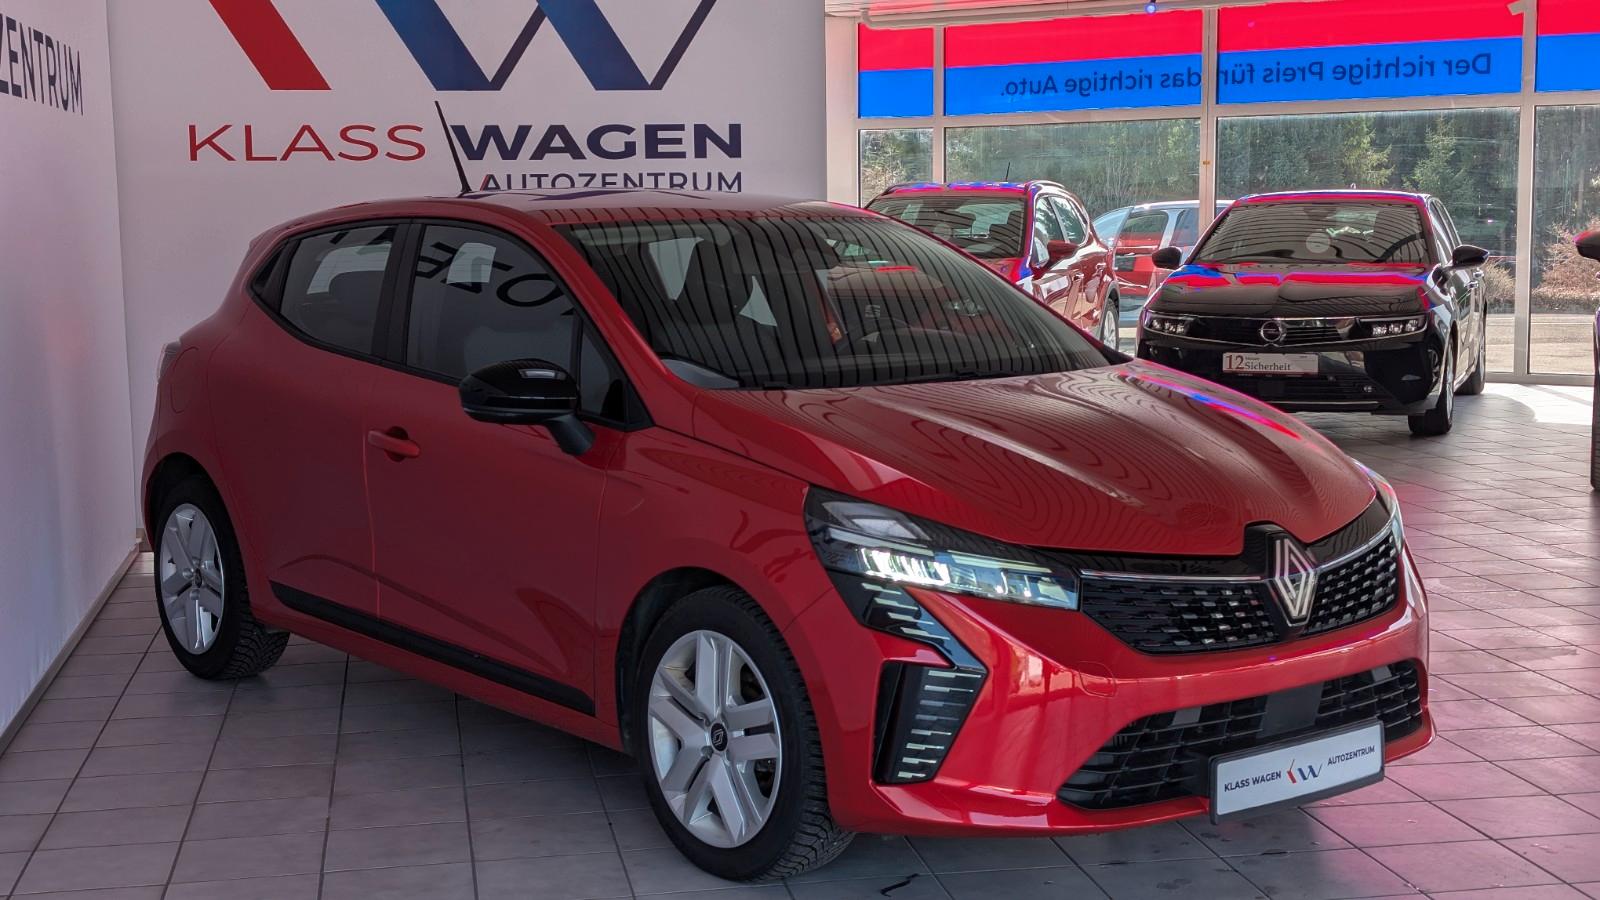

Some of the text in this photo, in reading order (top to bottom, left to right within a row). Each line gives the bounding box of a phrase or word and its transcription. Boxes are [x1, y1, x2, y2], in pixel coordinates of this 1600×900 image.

[188, 124, 742, 162] KLASS WAGEN
[1225, 354, 1291, 371] 12 Sicherheit
[1224, 778, 1250, 792] KLASS
[1252, 770, 1282, 785] WAGEN
[1327, 745, 1376, 766] AUTOZENTRUM
